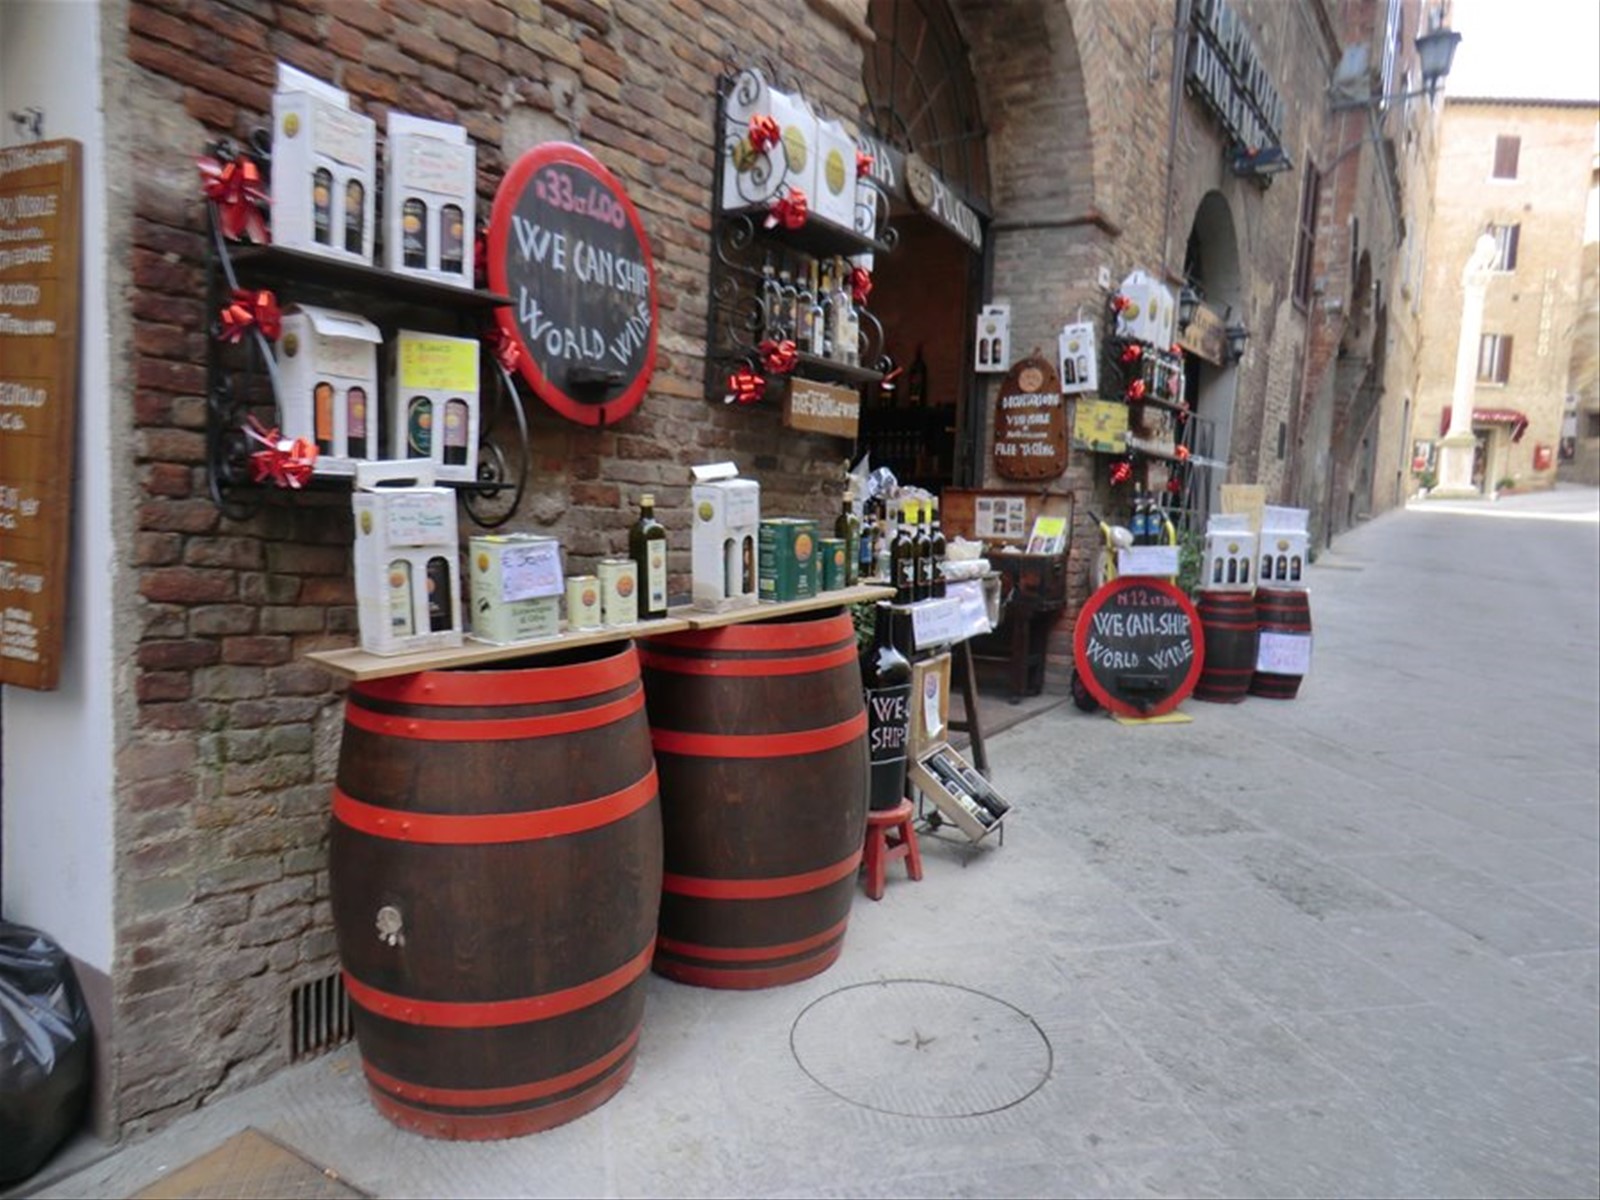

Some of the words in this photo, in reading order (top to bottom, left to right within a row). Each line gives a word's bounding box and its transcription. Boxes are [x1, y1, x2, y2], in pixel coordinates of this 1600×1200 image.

[511, 214, 567, 272] WE
[573, 240, 614, 287] CAN
[614, 257, 650, 298] SHIP
[519, 284, 606, 361] WORLD
[608, 301, 652, 366] WIDE
[1093, 612, 1124, 637] WE
[1126, 612, 1154, 638] CAN
[1085, 637, 1140, 669] WORLD
[1147, 638, 1194, 671] WIDE
[871, 696, 905, 722] WE
[871, 725, 905, 752] SHIP
